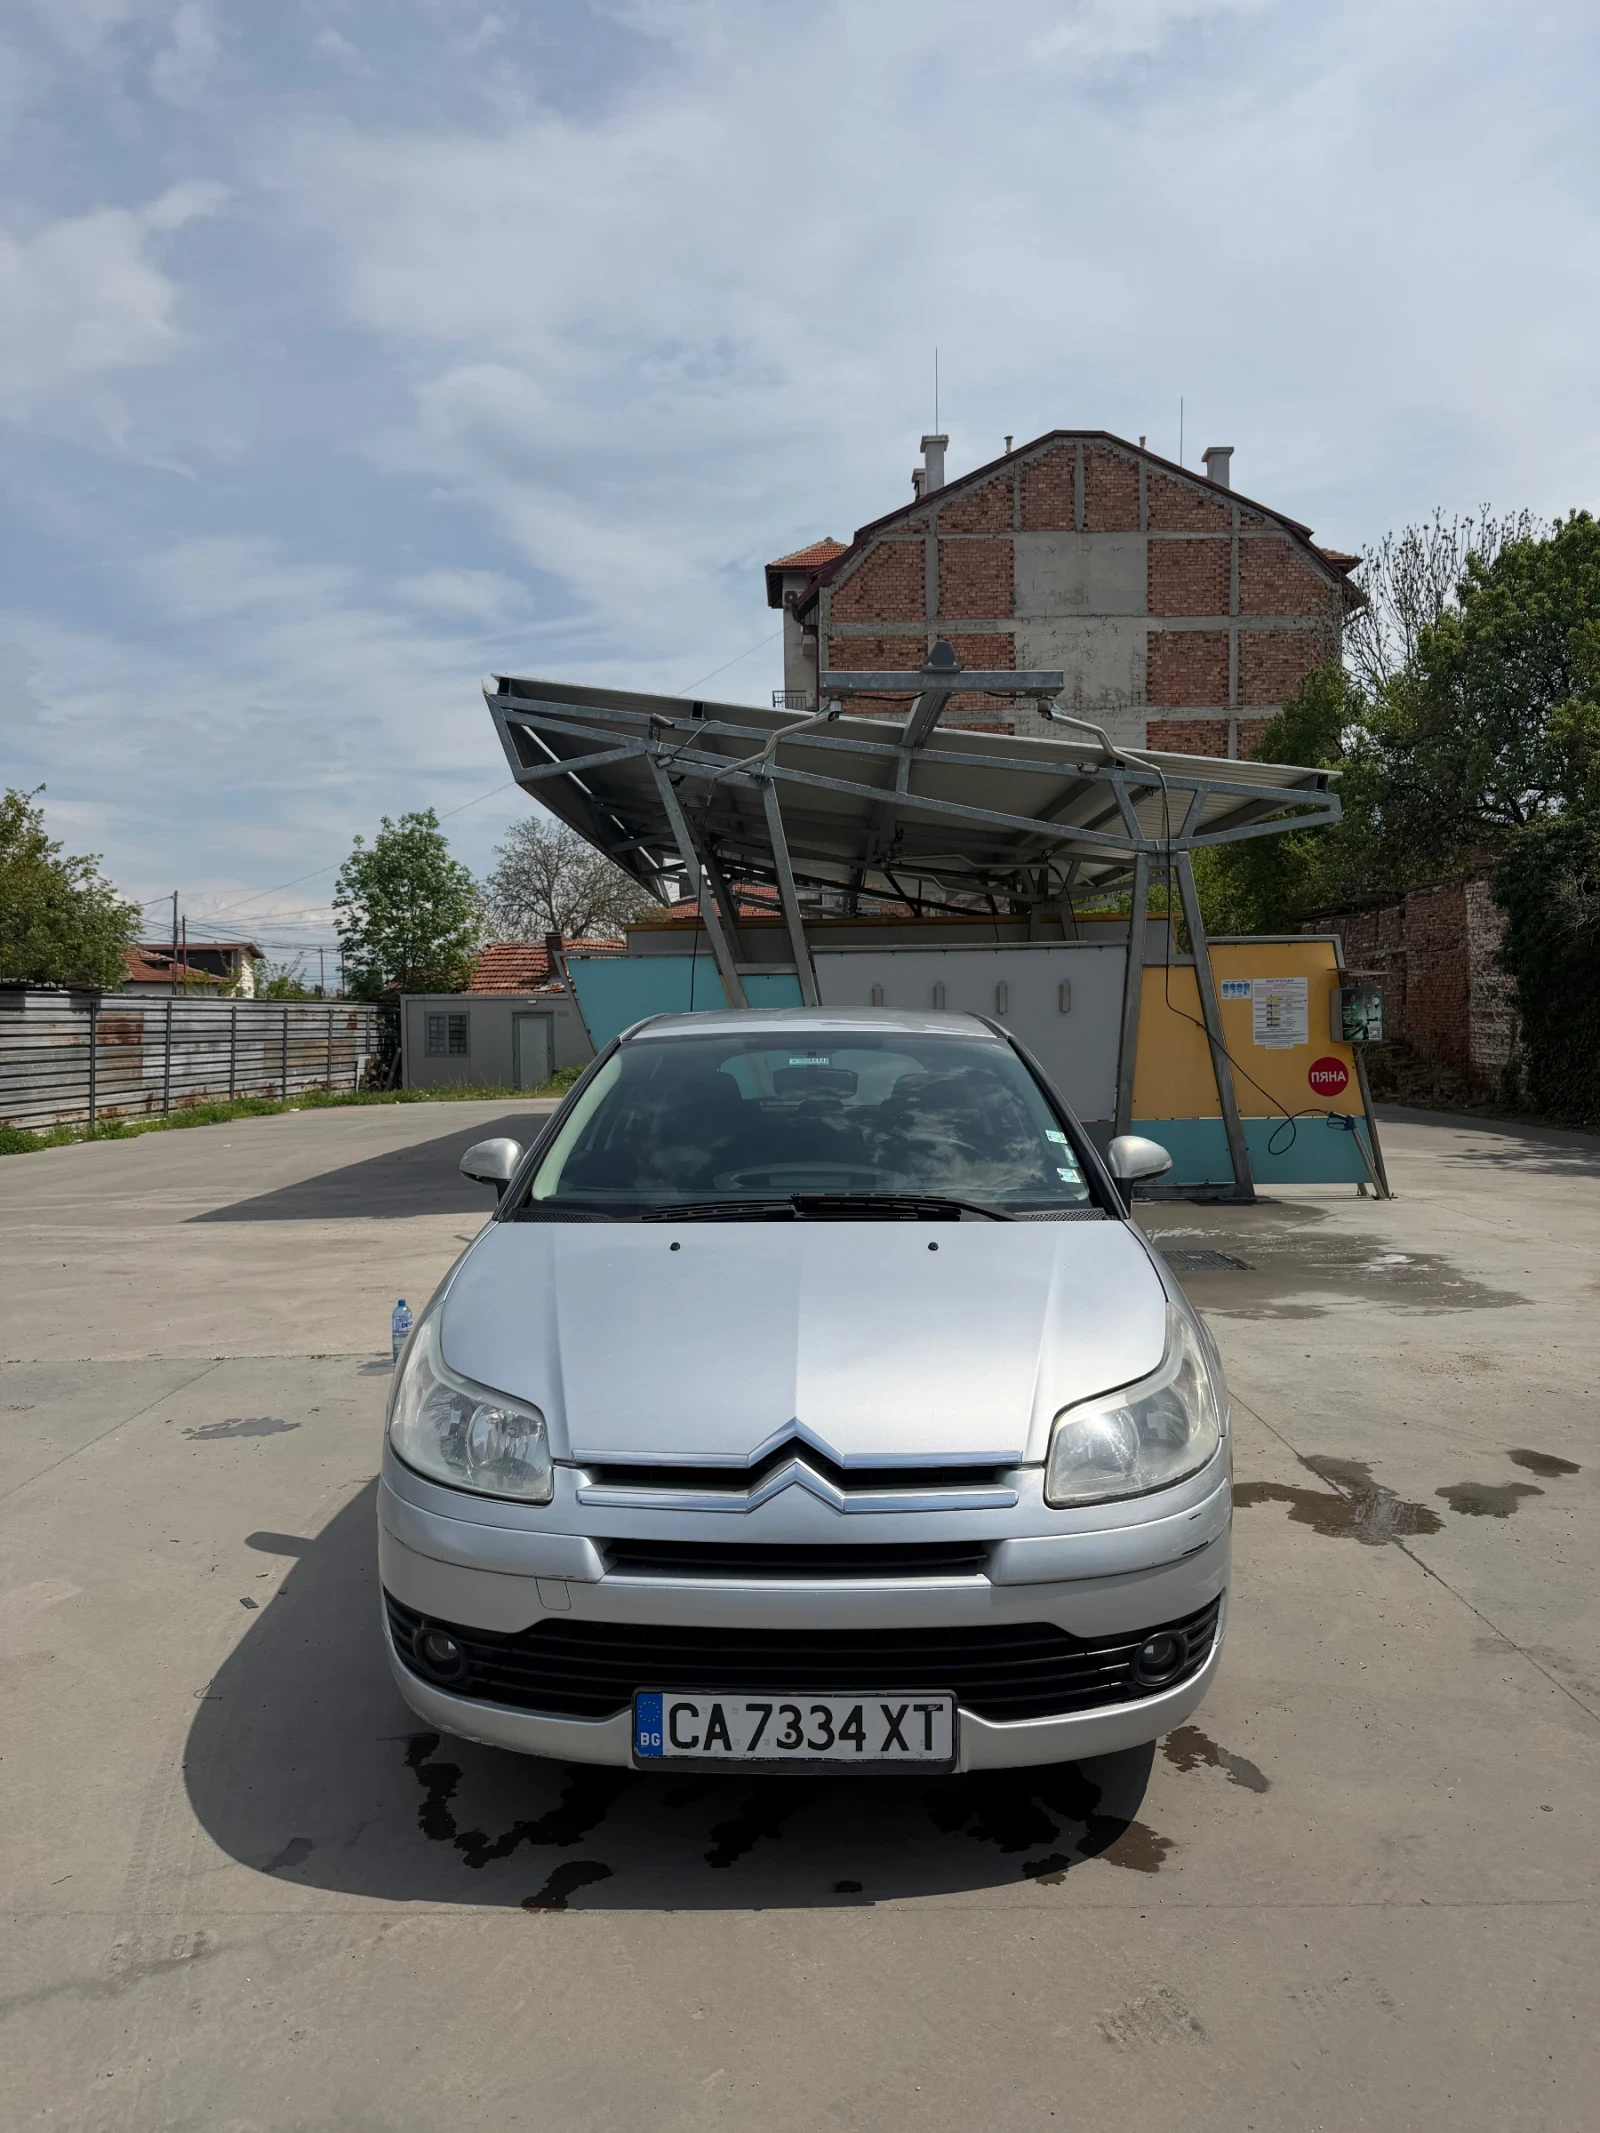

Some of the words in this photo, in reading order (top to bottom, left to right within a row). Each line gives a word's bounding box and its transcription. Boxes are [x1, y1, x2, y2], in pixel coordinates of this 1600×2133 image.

[1311, 1070, 1346, 1083] ПЯНА
[669, 1702, 733, 1751] CA
[746, 1703, 866, 1751] 7334
[880, 1703, 944, 1752] XT
[640, 1732, 660, 1746] BG
